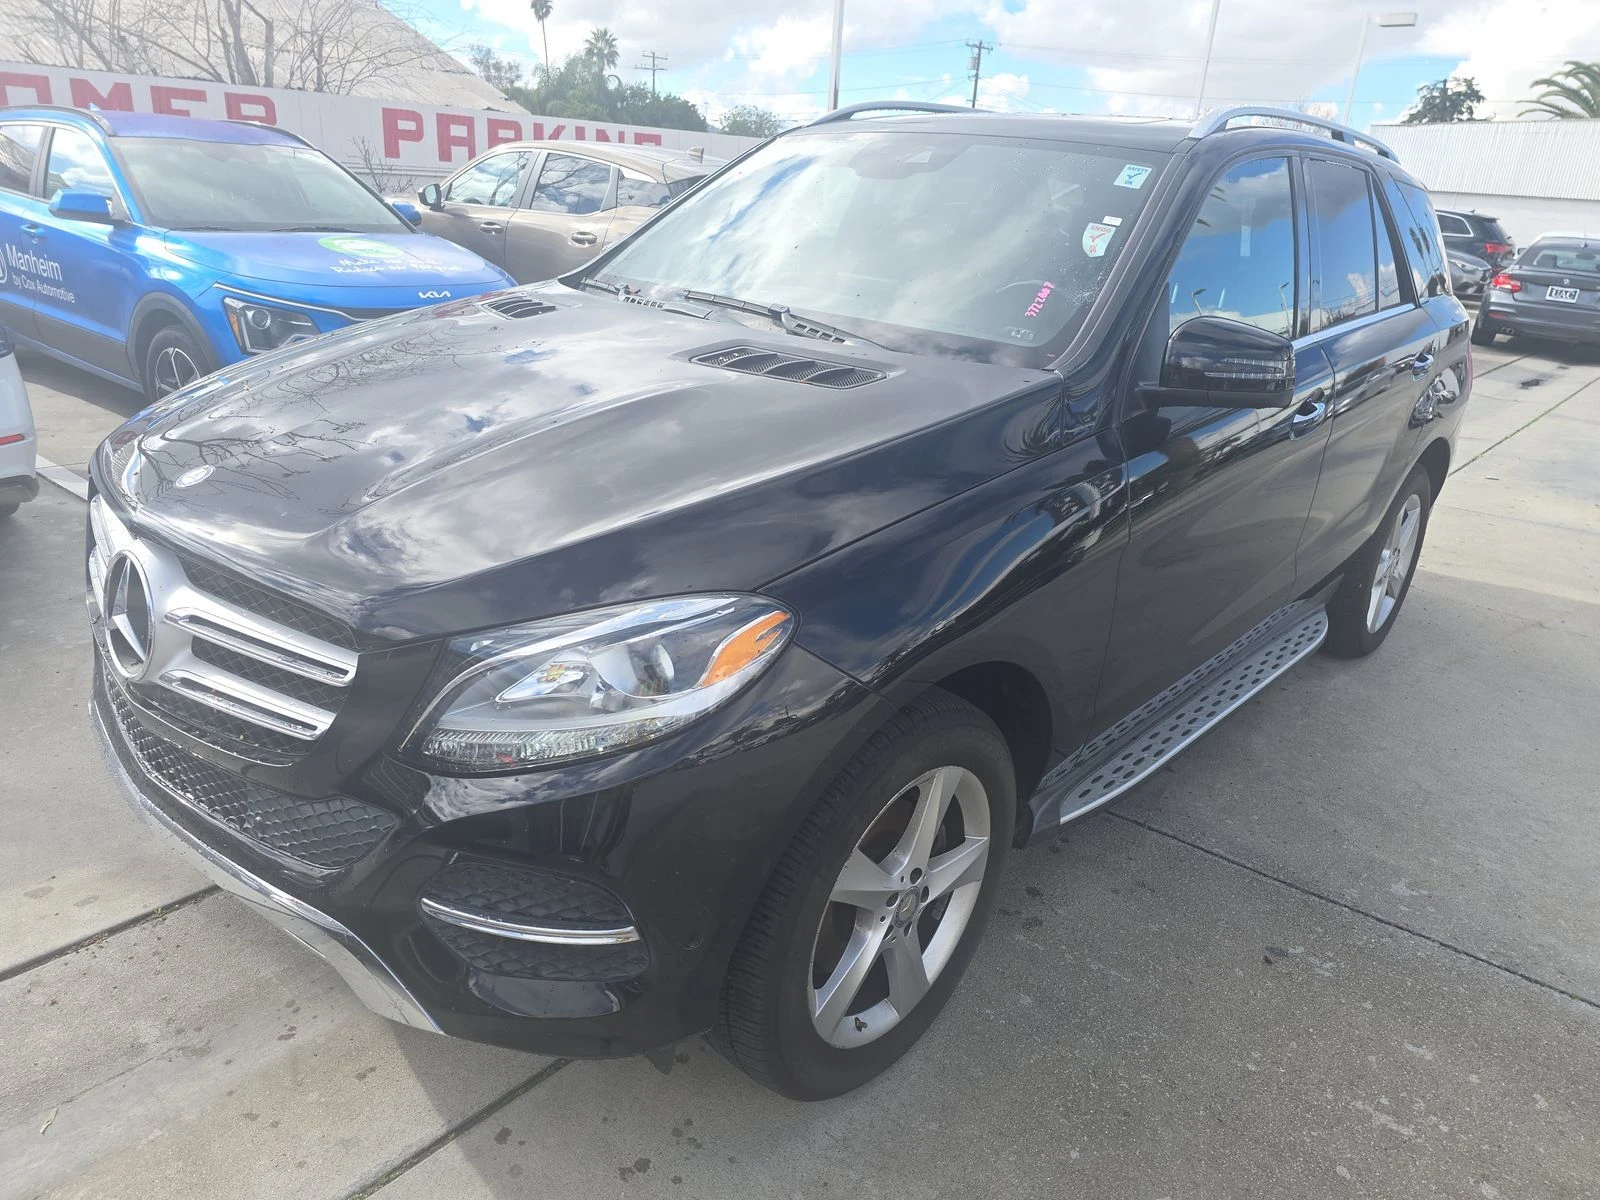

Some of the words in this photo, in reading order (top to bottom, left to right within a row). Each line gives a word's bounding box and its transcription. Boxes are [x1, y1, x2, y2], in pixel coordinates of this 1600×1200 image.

[5, 242, 63, 281] Manheim
[11, 271, 21, 289] by
[21, 274, 36, 290] Cox
[37, 279, 75, 304] Automotive
